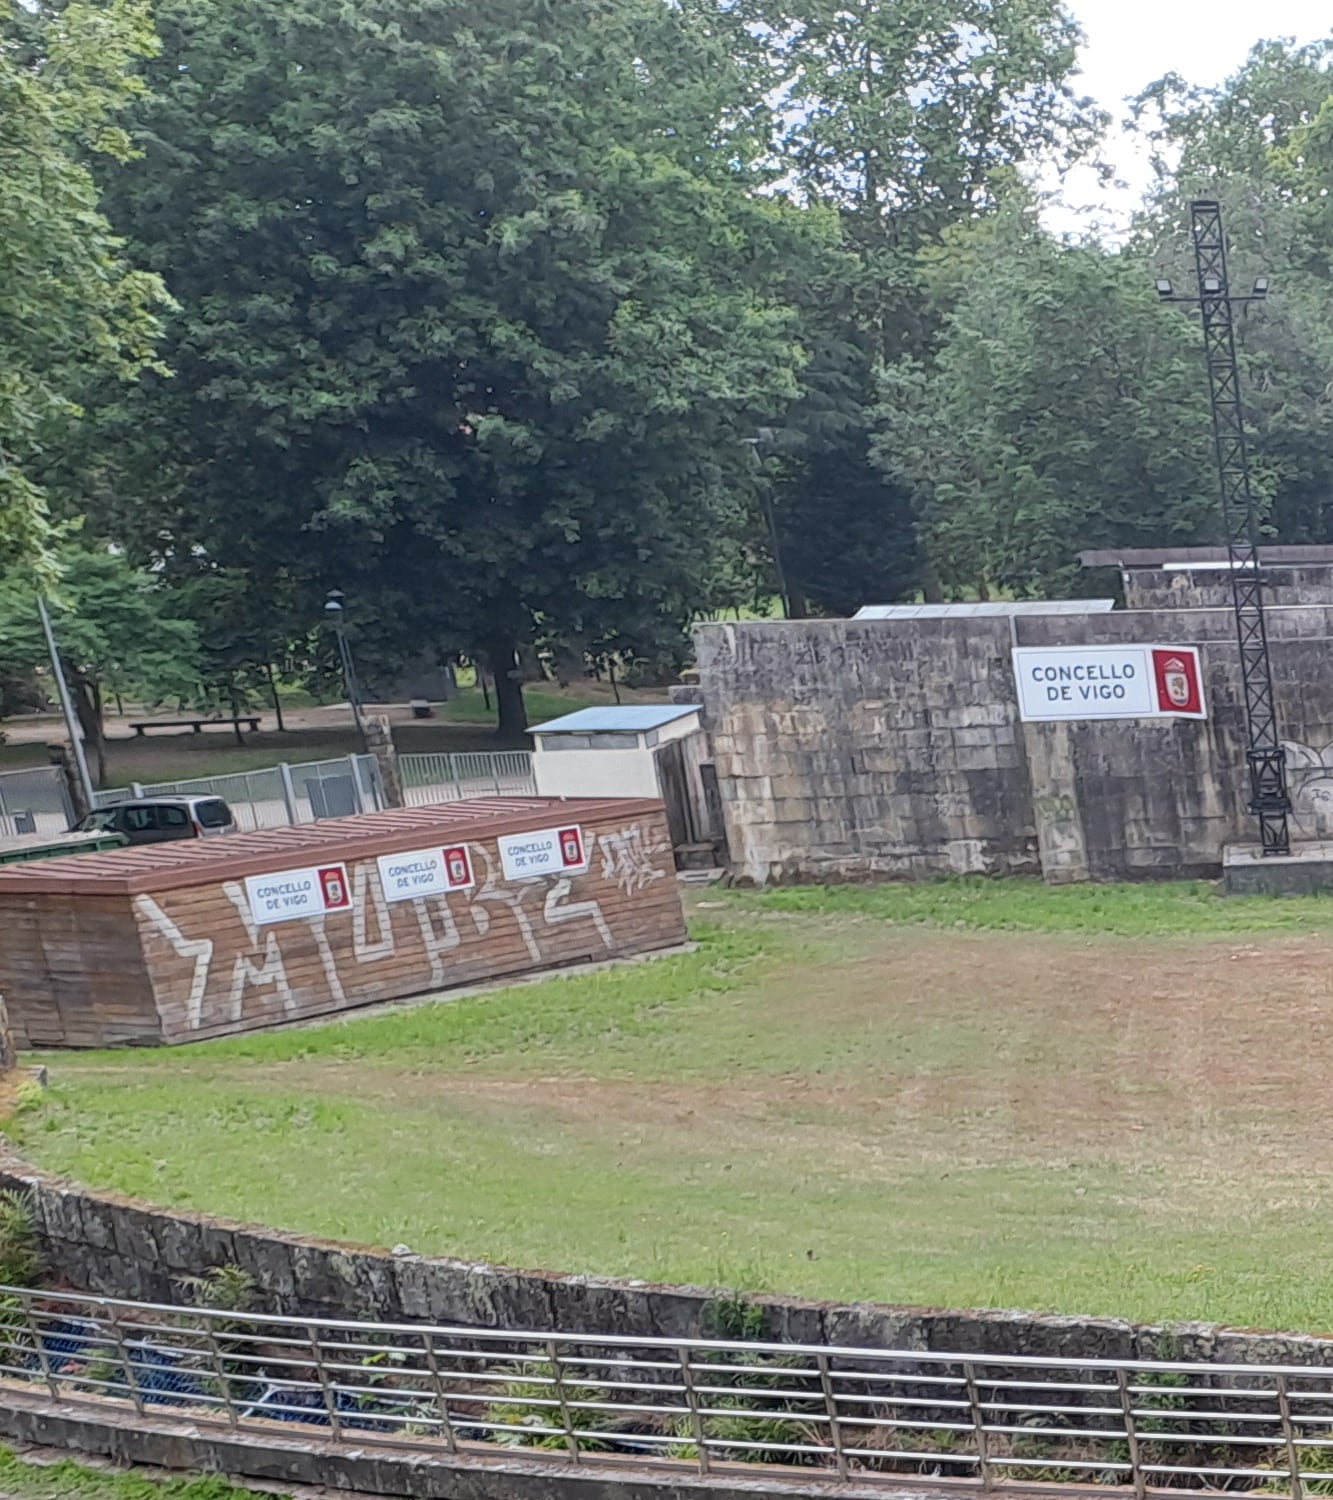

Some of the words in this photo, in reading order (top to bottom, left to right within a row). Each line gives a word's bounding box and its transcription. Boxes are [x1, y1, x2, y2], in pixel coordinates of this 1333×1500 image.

[1032, 664, 1135, 682] CONCELLO
[1047, 686, 1072, 701] DE
[1079, 684, 1125, 700] VIGO
[507, 840, 553, 856] CONCELLO
[515, 857, 528, 867] DE
[529, 853, 550, 865] VIGO
[388, 860, 437, 877] CONCELLO
[396, 877, 410, 888] DE
[411, 873, 434, 885] VIGO
[256, 880, 311, 899] CONCELLO
[266, 900, 281, 910] DE
[283, 894, 308, 907] VIGO
